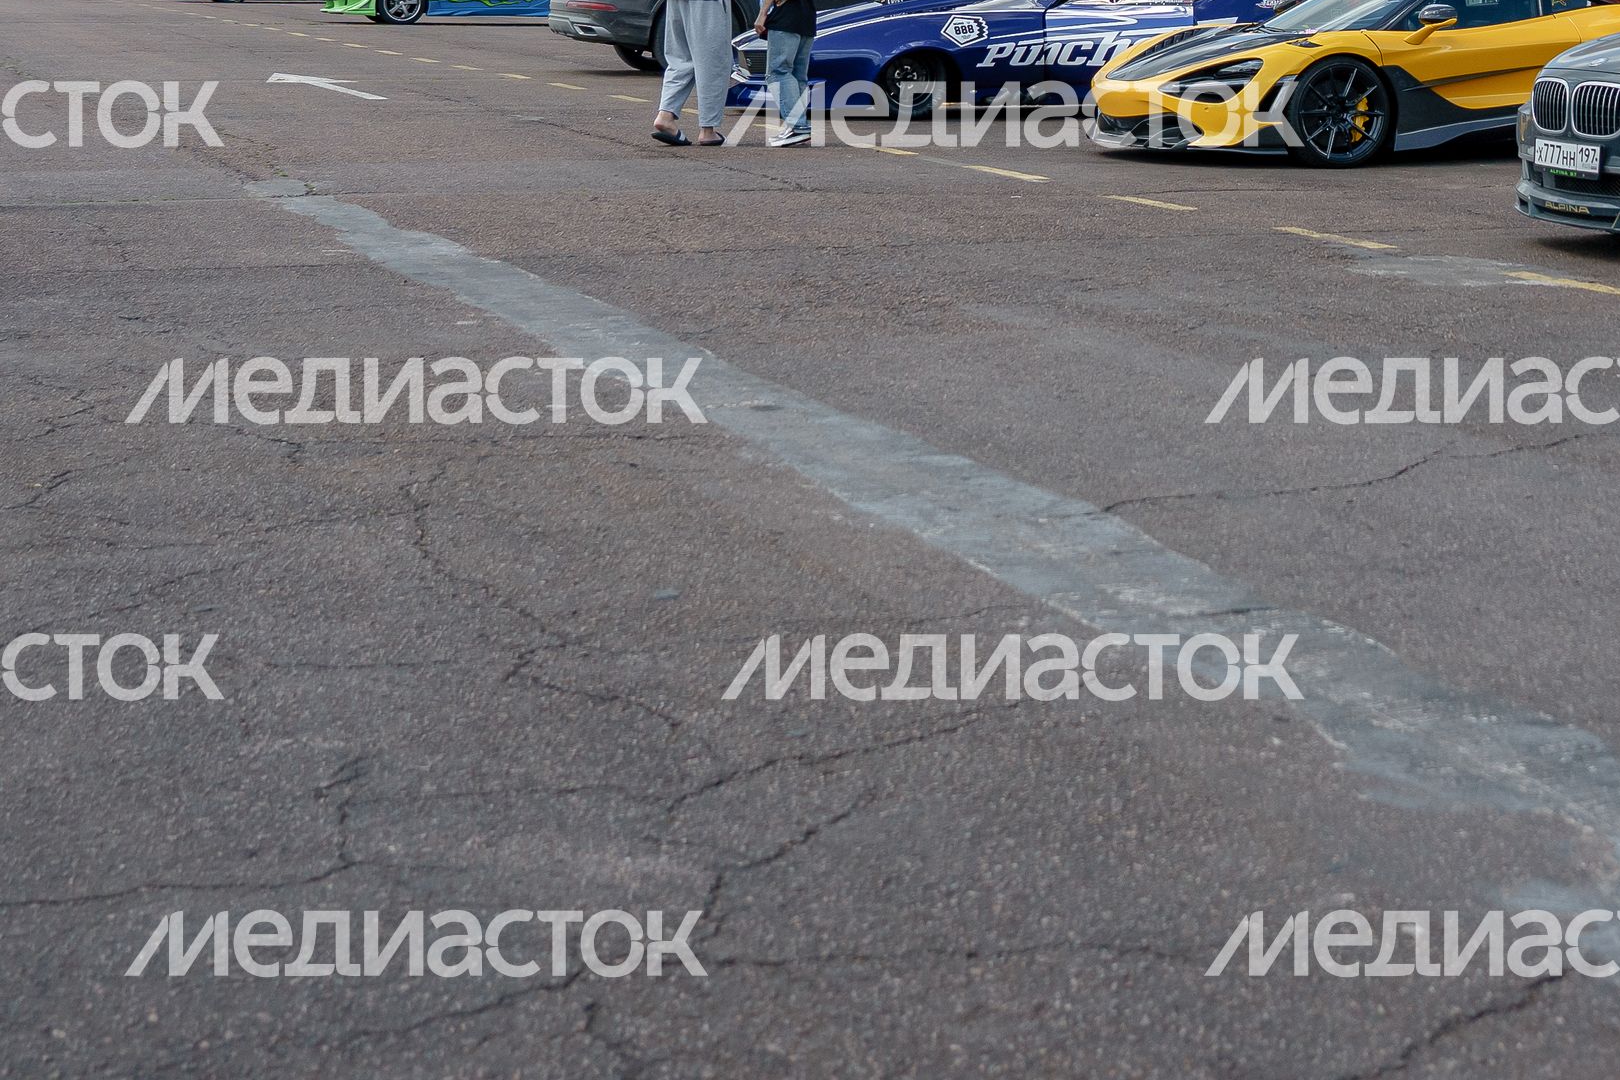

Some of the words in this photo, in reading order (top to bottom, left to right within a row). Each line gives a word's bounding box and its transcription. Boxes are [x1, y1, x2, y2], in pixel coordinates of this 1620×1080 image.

[954, 24, 975, 36] 888
[1579, 146, 1597, 164] 197
[1549, 168, 1568, 176] ALPINA
[1545, 201, 1590, 215] ALPINA
